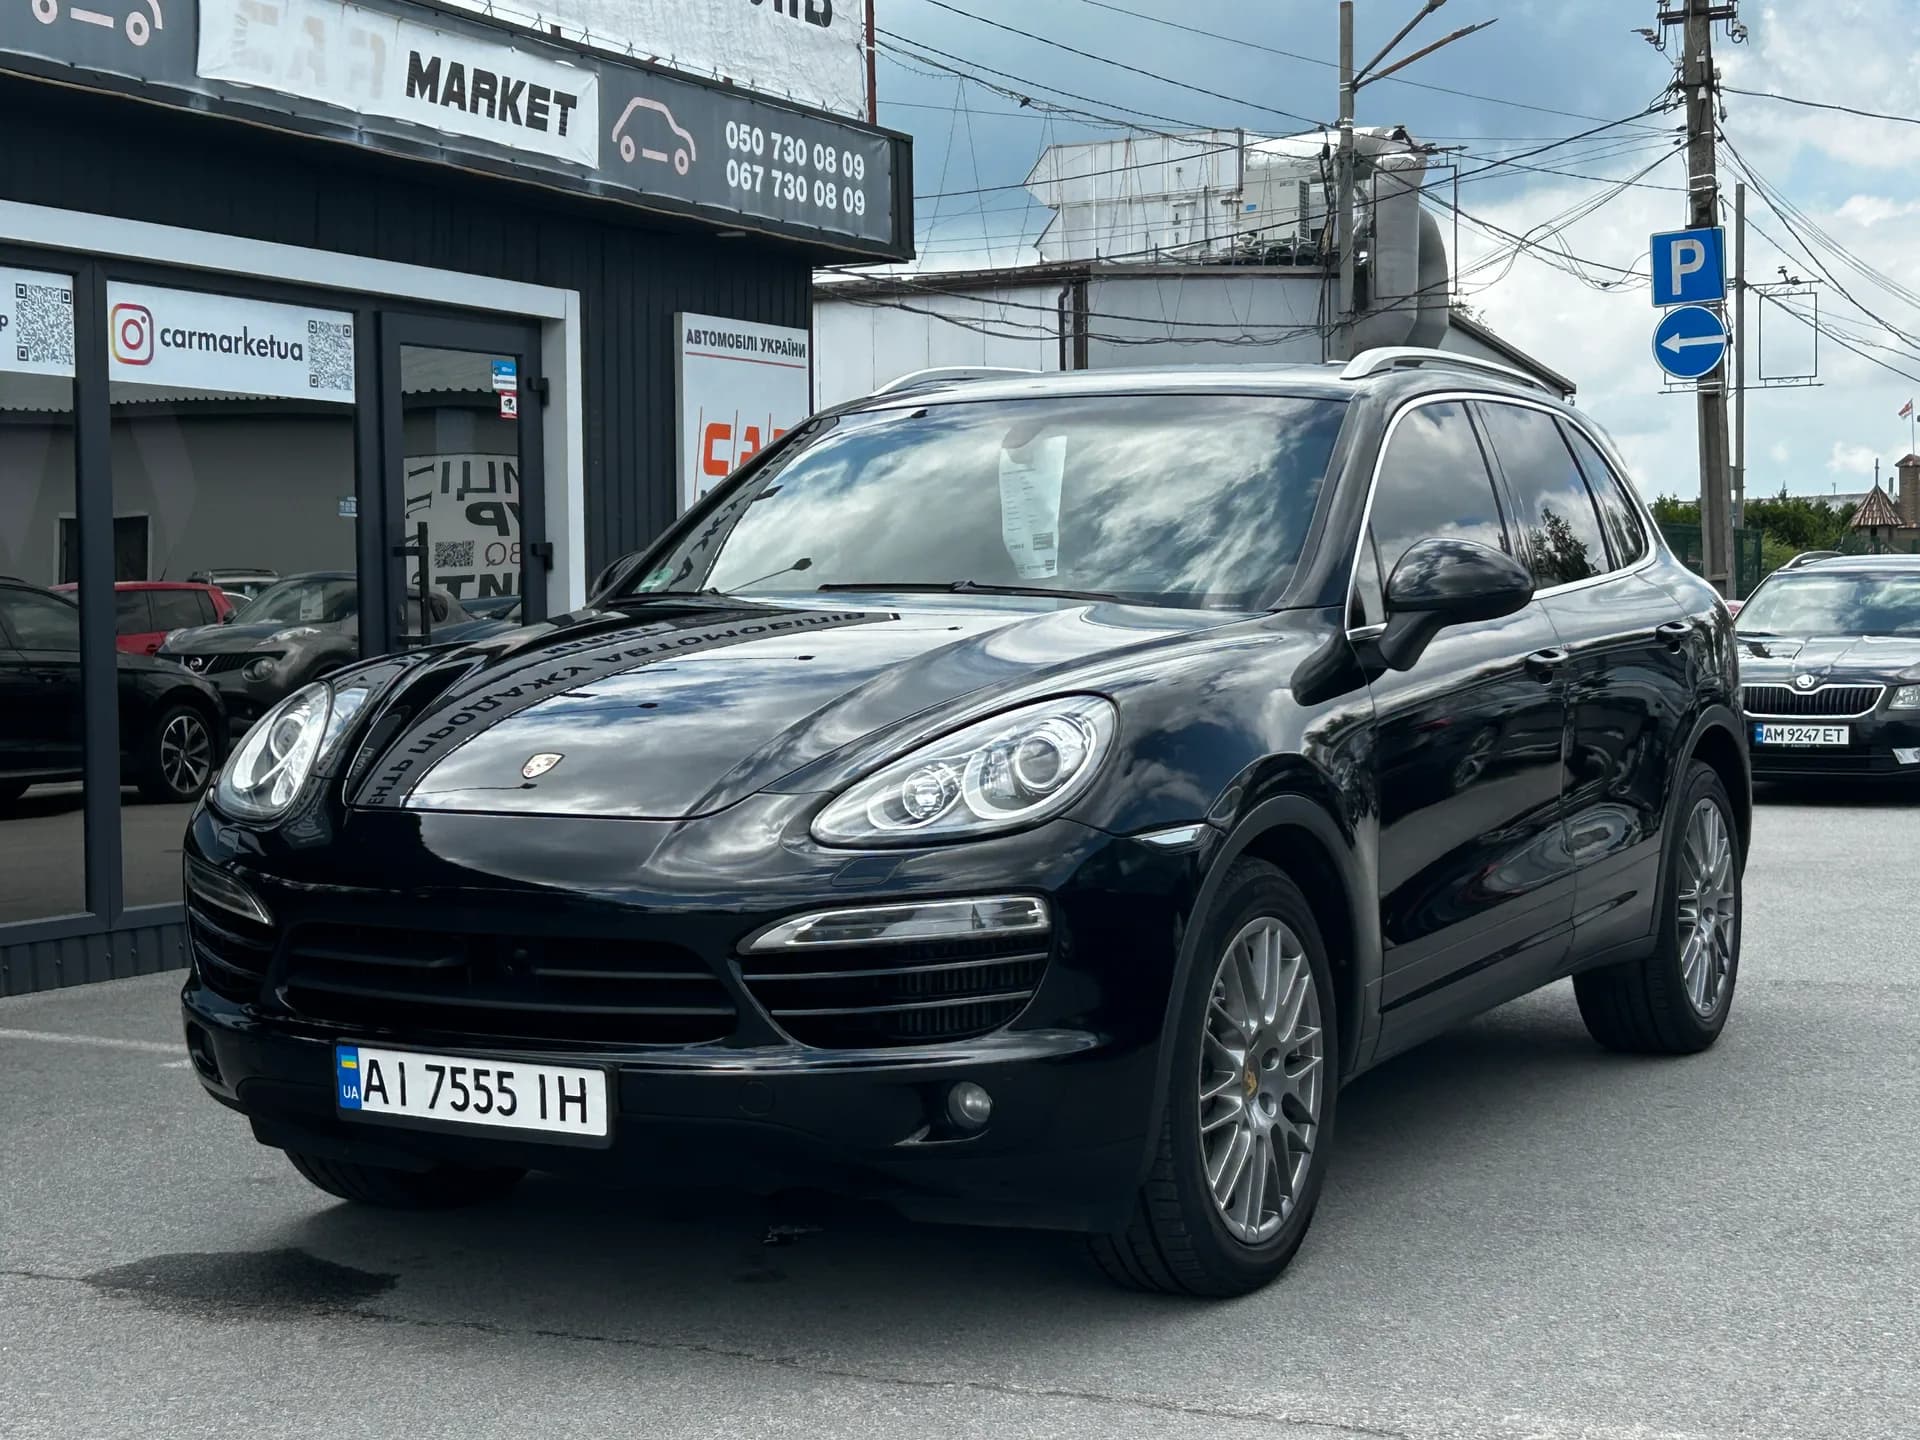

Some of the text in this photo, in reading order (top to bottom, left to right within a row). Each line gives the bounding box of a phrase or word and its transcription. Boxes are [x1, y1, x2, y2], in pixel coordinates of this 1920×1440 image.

[406, 50, 578, 137] MARKET
[725, 120, 865, 181] 050 730 08 09
[726, 159, 865, 216] 067 730 08 09
[1670, 238, 1705, 296] P
[160, 326, 304, 362] carmarketua
[686, 328, 806, 359] АВТОМОБІЛІ УКРАЇНИ
[703, 423, 785, 477] CA
[1764, 728, 1844, 743] AM 9247 ET
[343, 1058, 588, 1124] UA AI 7555 IH
